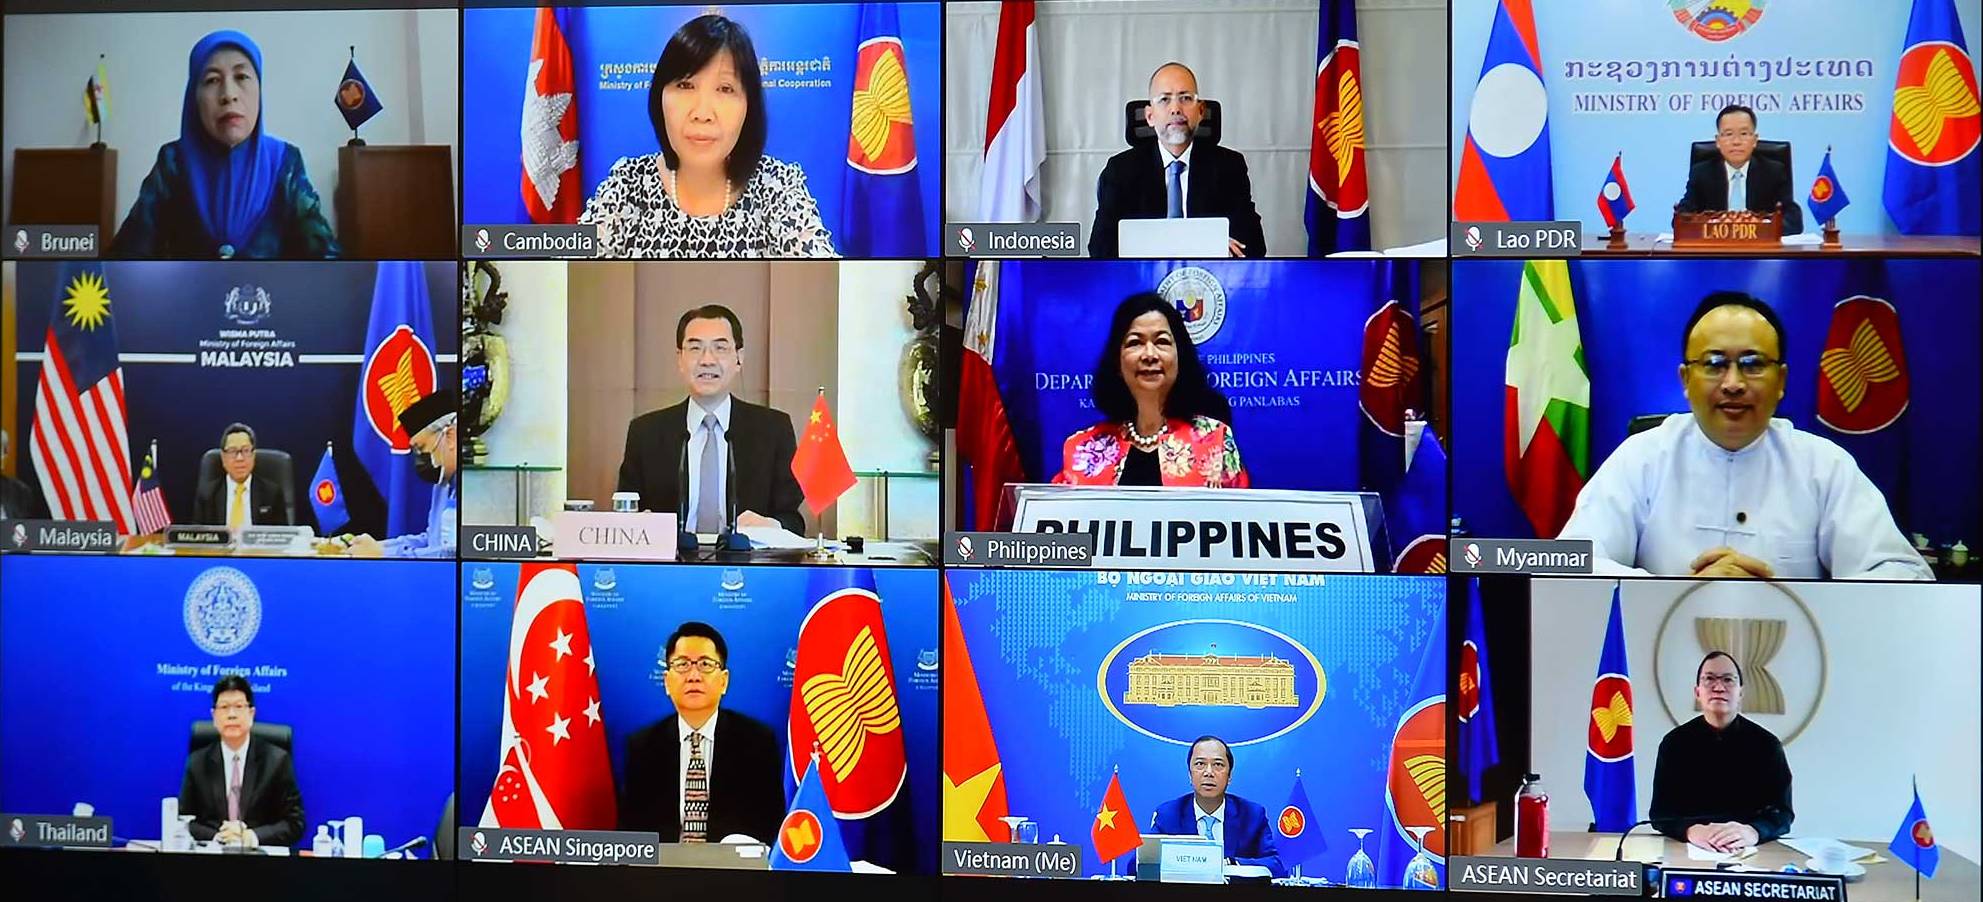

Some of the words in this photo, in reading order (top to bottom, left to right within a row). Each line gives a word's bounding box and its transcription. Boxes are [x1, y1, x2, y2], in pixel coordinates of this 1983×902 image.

[599, 81, 632, 91] Ministry
[634, 81, 643, 89] of
[778, 79, 831, 89] Cooperation
[1574, 94, 1660, 112] MINISTRY
[1668, 94, 1693, 112] OF
[1788, 94, 1864, 111] AFFAIRS
[1497, 229, 1530, 249] Lao
[1535, 229, 1577, 249] PDR
[1703, 223, 1729, 239] LAO
[1732, 223, 1758, 239] PDR
[41, 232, 94, 252] Brunei
[503, 232, 592, 251] Cambodia
[989, 231, 1075, 250] Indonesia
[248, 330, 276, 338] PUTRA
[199, 340, 230, 349] Ministry
[231, 340, 240, 348] of
[241, 340, 269, 349] Foreign
[271, 340, 296, 348] Affairs
[200, 351, 295, 368] MALAYSIA
[1207, 352, 1276, 365] PHILIPPINES
[1035, 372, 1094, 390] DEPAR
[1207, 371, 1278, 388] OREIGN
[1282, 369, 1362, 387] AFFAIRS
[1239, 395, 1300, 408] PANLABAS
[39, 527, 112, 550] Malaysia
[177, 532, 219, 542] MALAYSIA
[472, 533, 532, 552] CHINA
[579, 527, 650, 546] CHINA
[987, 540, 1088, 564] Philippines
[1497, 547, 1588, 571] Myanmar
[1190, 572, 1236, 586] GIAO
[1283, 574, 1325, 586] NAM
[1126, 592, 1162, 601] MINISTRY
[1164, 592, 1176, 601] OF
[1177, 593, 1213, 602] FOREIGN
[1214, 593, 1246, 602] AFFAIRS
[1248, 593, 1260, 602] OF
[1261, 594, 1298, 603] VIETNAM
[157, 663, 198, 677] Ministry
[200, 664, 212, 674] of
[213, 665, 251, 678] Foreign
[252, 666, 287, 677] Affairs
[194, 682, 214, 693] King
[37, 822, 108, 842] Thailand
[499, 836, 560, 855] ASEAN
[565, 838, 654, 861] Singapore
[954, 850, 1030, 870] Vietnam
[1035, 852, 1077, 874] (Me)
[1461, 864, 1529, 885] ASEAN
[1534, 867, 1637, 889] Secretariat
[1694, 880, 1742, 897] ASEAN
[1744, 883, 1836, 900] SECRETARIAT
